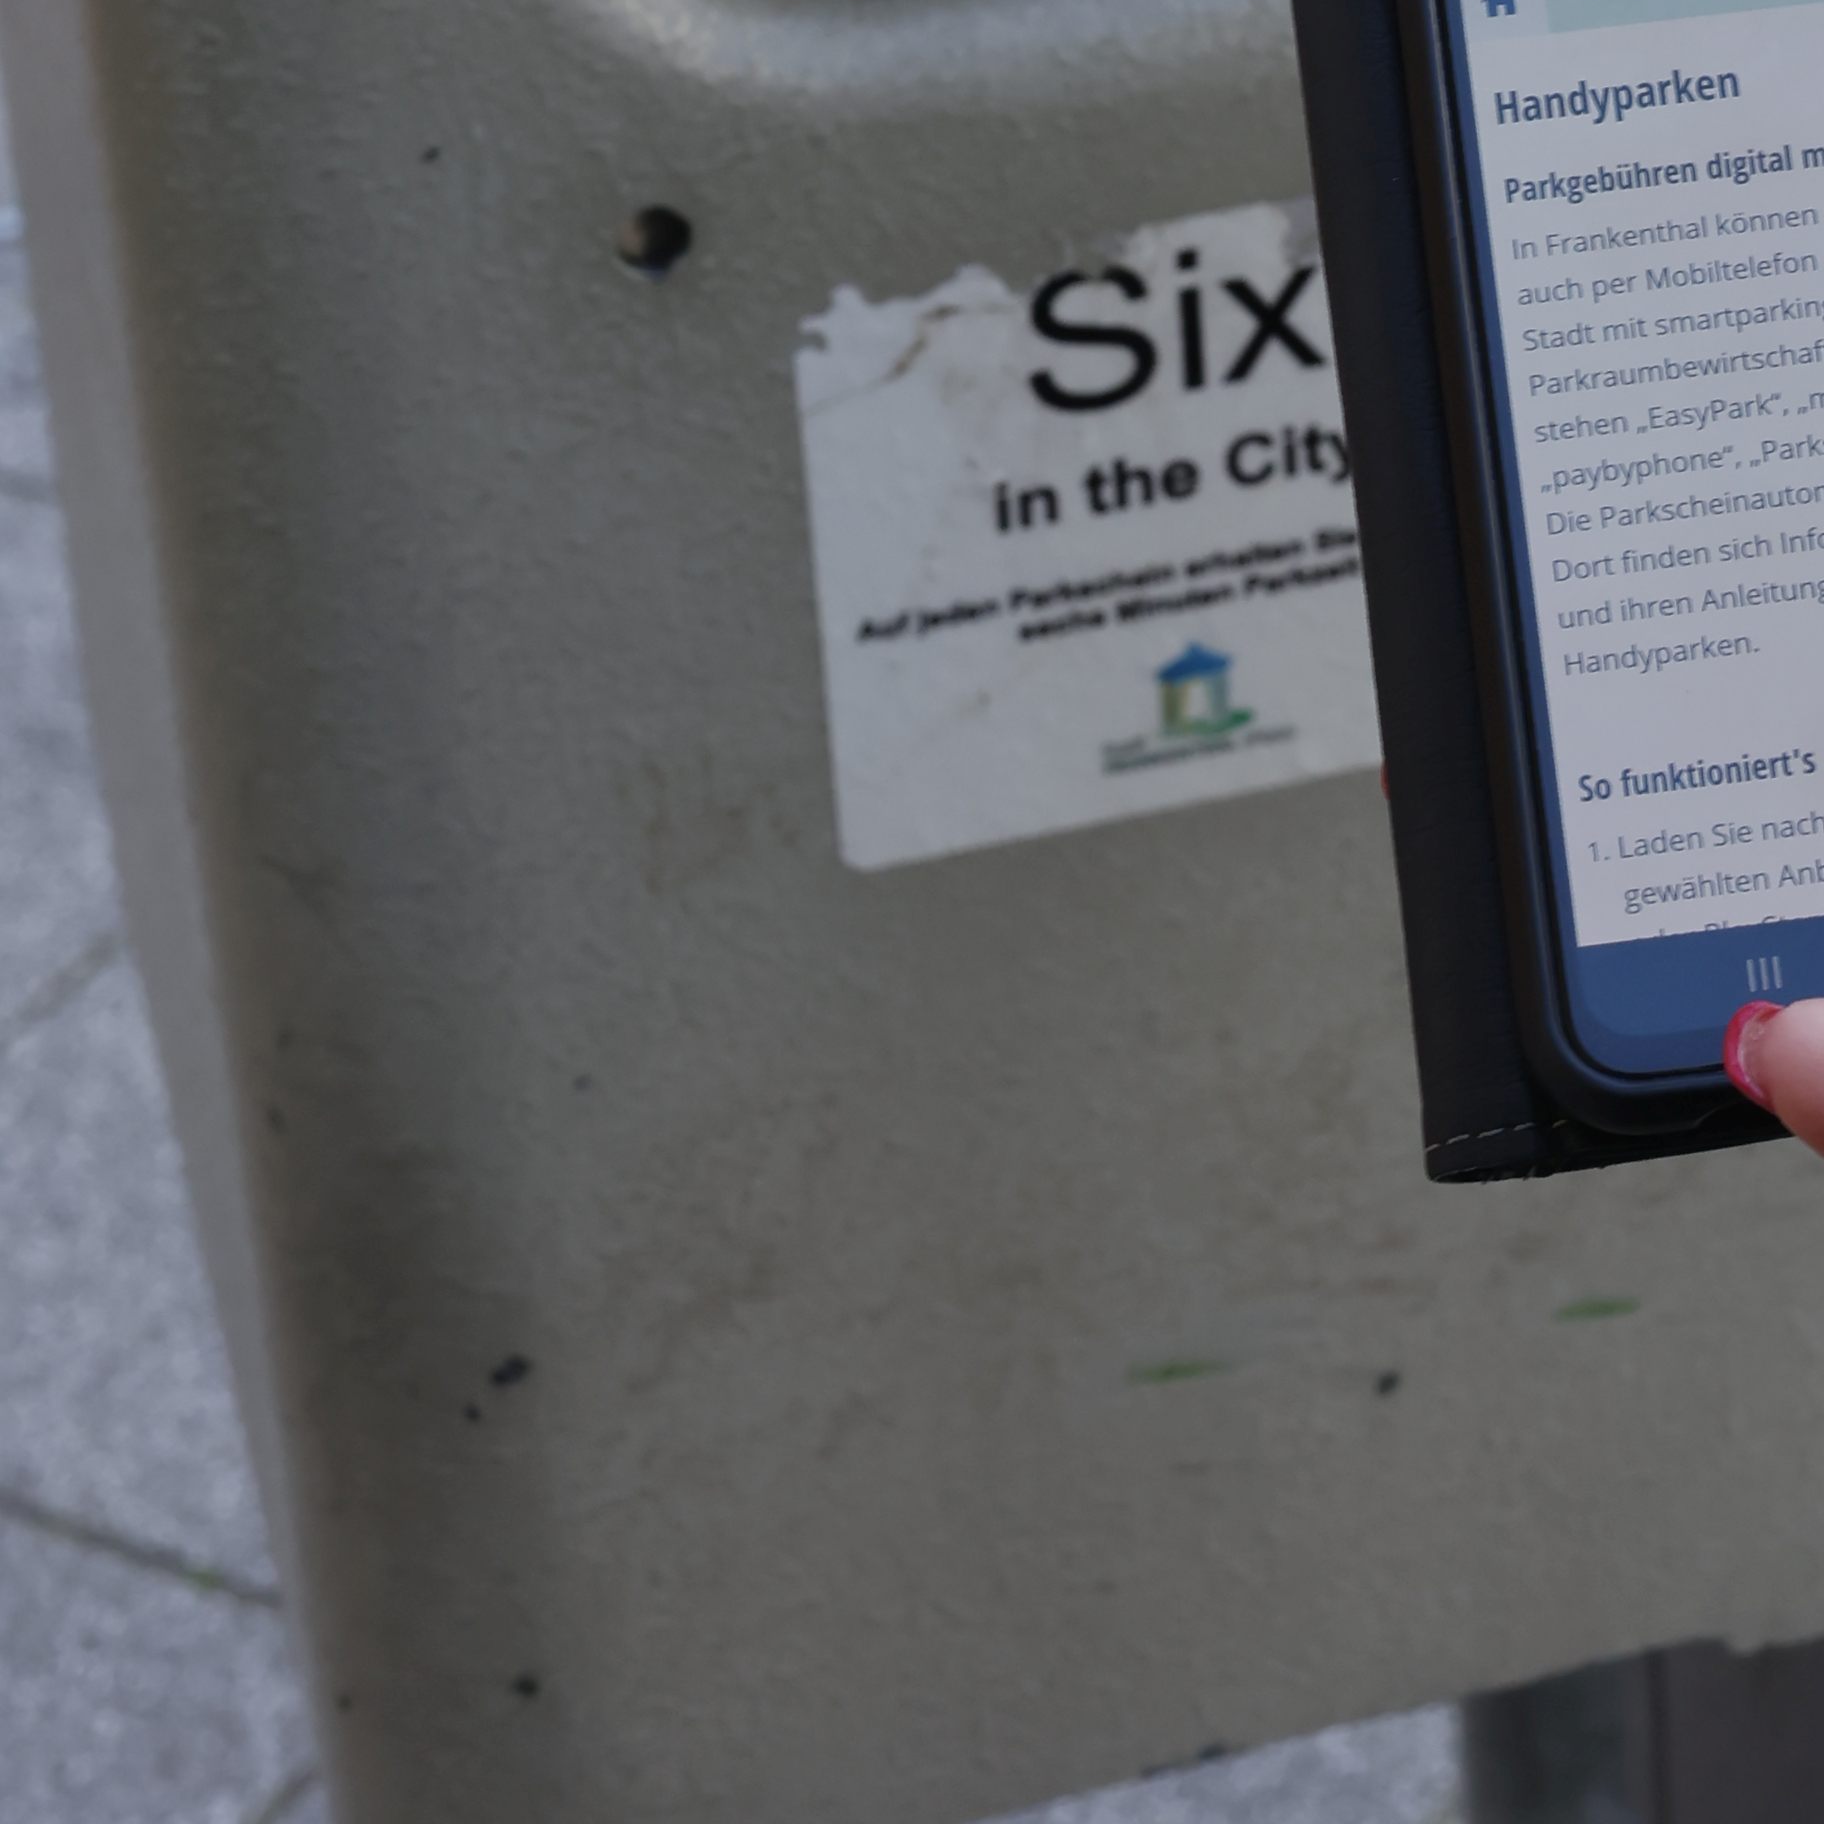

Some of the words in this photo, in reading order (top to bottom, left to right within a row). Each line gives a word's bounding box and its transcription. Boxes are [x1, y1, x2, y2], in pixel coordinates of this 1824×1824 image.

[1493, 68, 1740, 125] Handyparken
[1502, 160, 1698, 205] Parkgebühren
[1705, 143, 1794, 185] digital
[1510, 238, 1539, 260] In
[1544, 214, 1708, 257] Frankenthal
[1713, 206, 1819, 237] können
[1516, 276, 1584, 306] auch
[1590, 274, 1638, 304] per
[1644, 250, 1818, 291] Mobiltelefon
[1030, 248, 1327, 412] Six
[1521, 321, 1596, 353] Stadt
[1601, 316, 1649, 342] mit
[1532, 414, 1630, 444] stehen
[994, 482, 1060, 534] in
[1082, 457, 1201, 516] the
[1224, 420, 1353, 488] City
[1545, 509, 1593, 536] Die
[1550, 554, 1616, 584] Dort
[1619, 543, 1712, 574] finden
[1717, 533, 1773, 562] sich
[1556, 599, 1613, 629] und
[1618, 595, 1694, 622] ihren
[1562, 634, 1761, 676] Handyparken.
[1577, 773, 1612, 803] So
[1618, 747, 1817, 797] funktioniert's
[1587, 840, 1610, 862] 1.
[1616, 828, 1705, 859] Laden
[1710, 821, 1753, 847] Sie
[1622, 871, 1770, 915] gewählten
